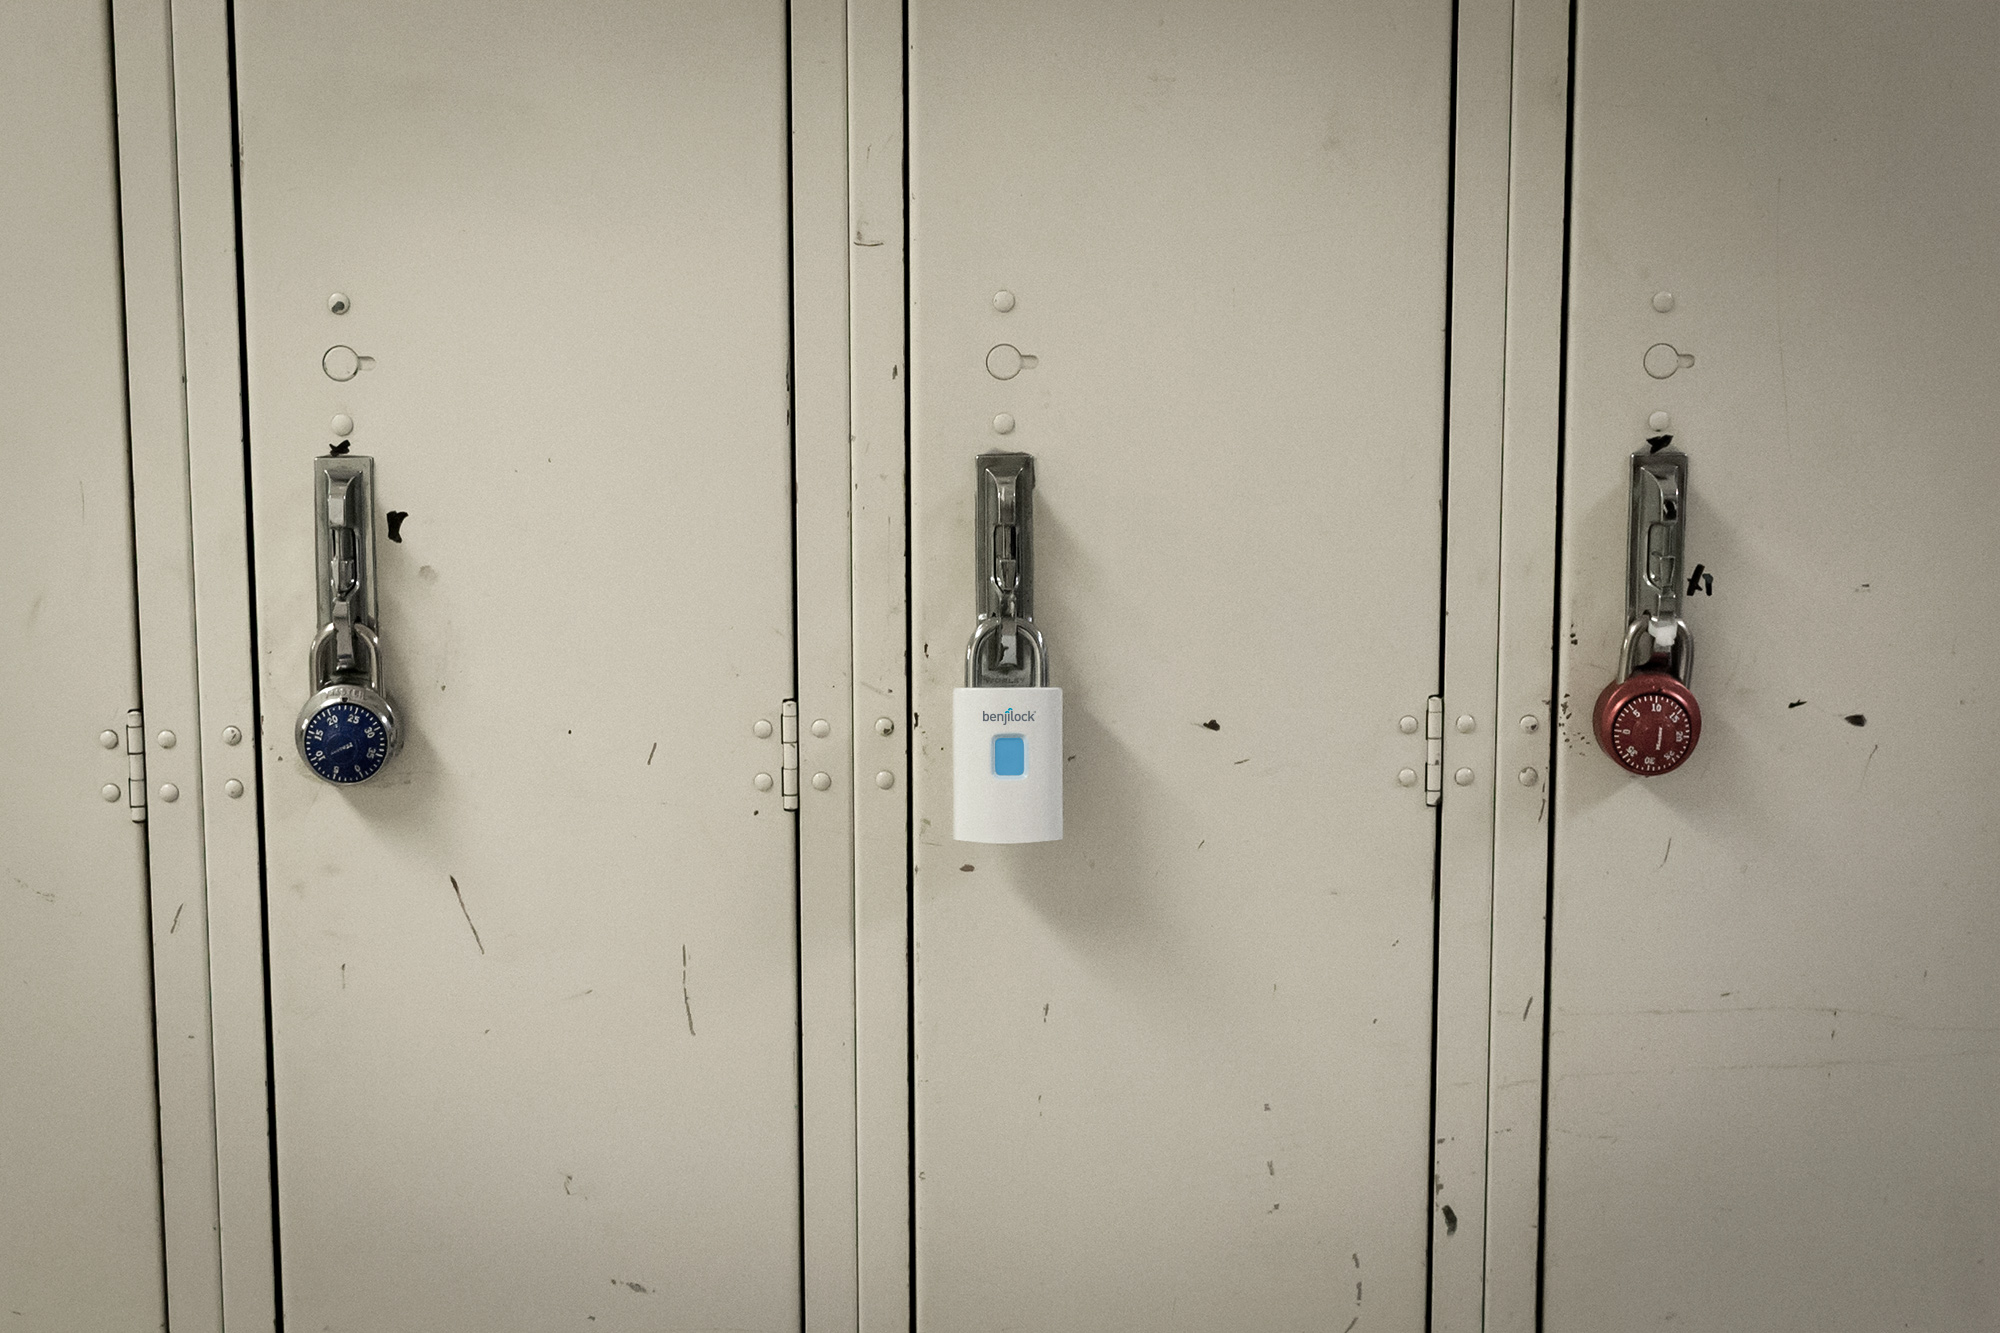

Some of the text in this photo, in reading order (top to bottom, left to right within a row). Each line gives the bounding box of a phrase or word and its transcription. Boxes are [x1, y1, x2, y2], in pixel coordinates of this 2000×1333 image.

[1651, 703, 1662, 712] 10
[347, 714, 360, 724] 25
[982, 707, 1035, 725] benjilock
[1633, 709, 1641, 718] 5
[1669, 712, 1680, 723] 15
[326, 715, 338, 726] 20
[314, 729, 323, 741] 15
[364, 727, 375, 738] 30
[1675, 731, 1684, 742] 20
[315, 750, 326, 761] 10
[366, 747, 376, 759] 35
[1626, 746, 1638, 757] 35
[1663, 750, 1675, 760] 25
[1644, 756, 1656, 765] 30
[333, 765, 340, 774] 5
[354, 764, 361, 772] 0
